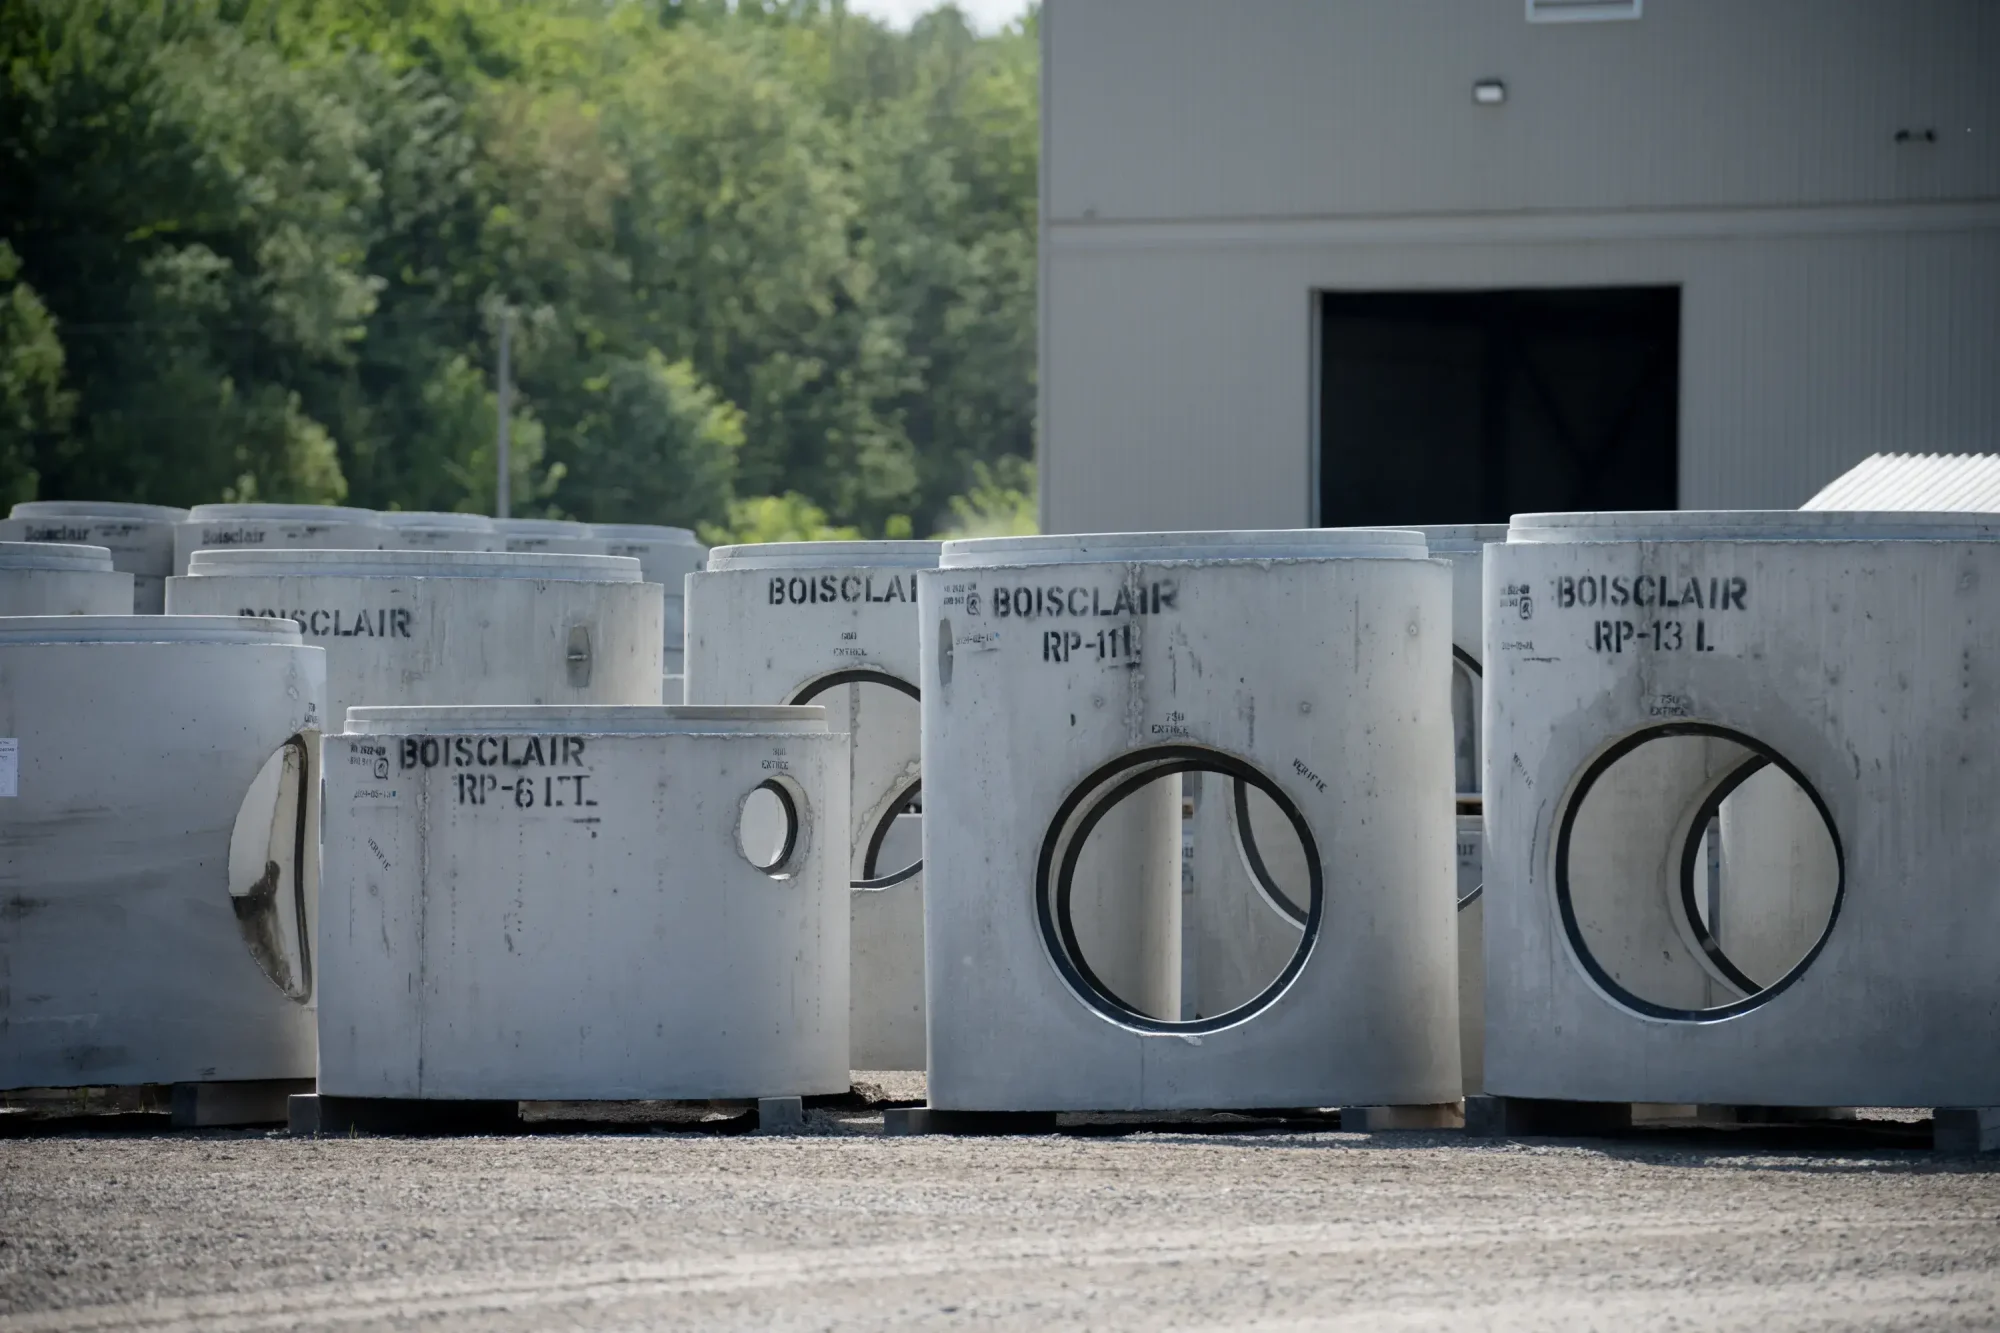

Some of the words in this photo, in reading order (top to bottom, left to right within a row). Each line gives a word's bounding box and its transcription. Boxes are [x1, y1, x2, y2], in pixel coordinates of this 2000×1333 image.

[769, 575, 917, 604] BOISCLAI
[994, 580, 1178, 617] BOISCLAIR
[1557, 575, 1748, 610] BOISCLAIR
[400, 736, 586, 769] BOISCLAIR
